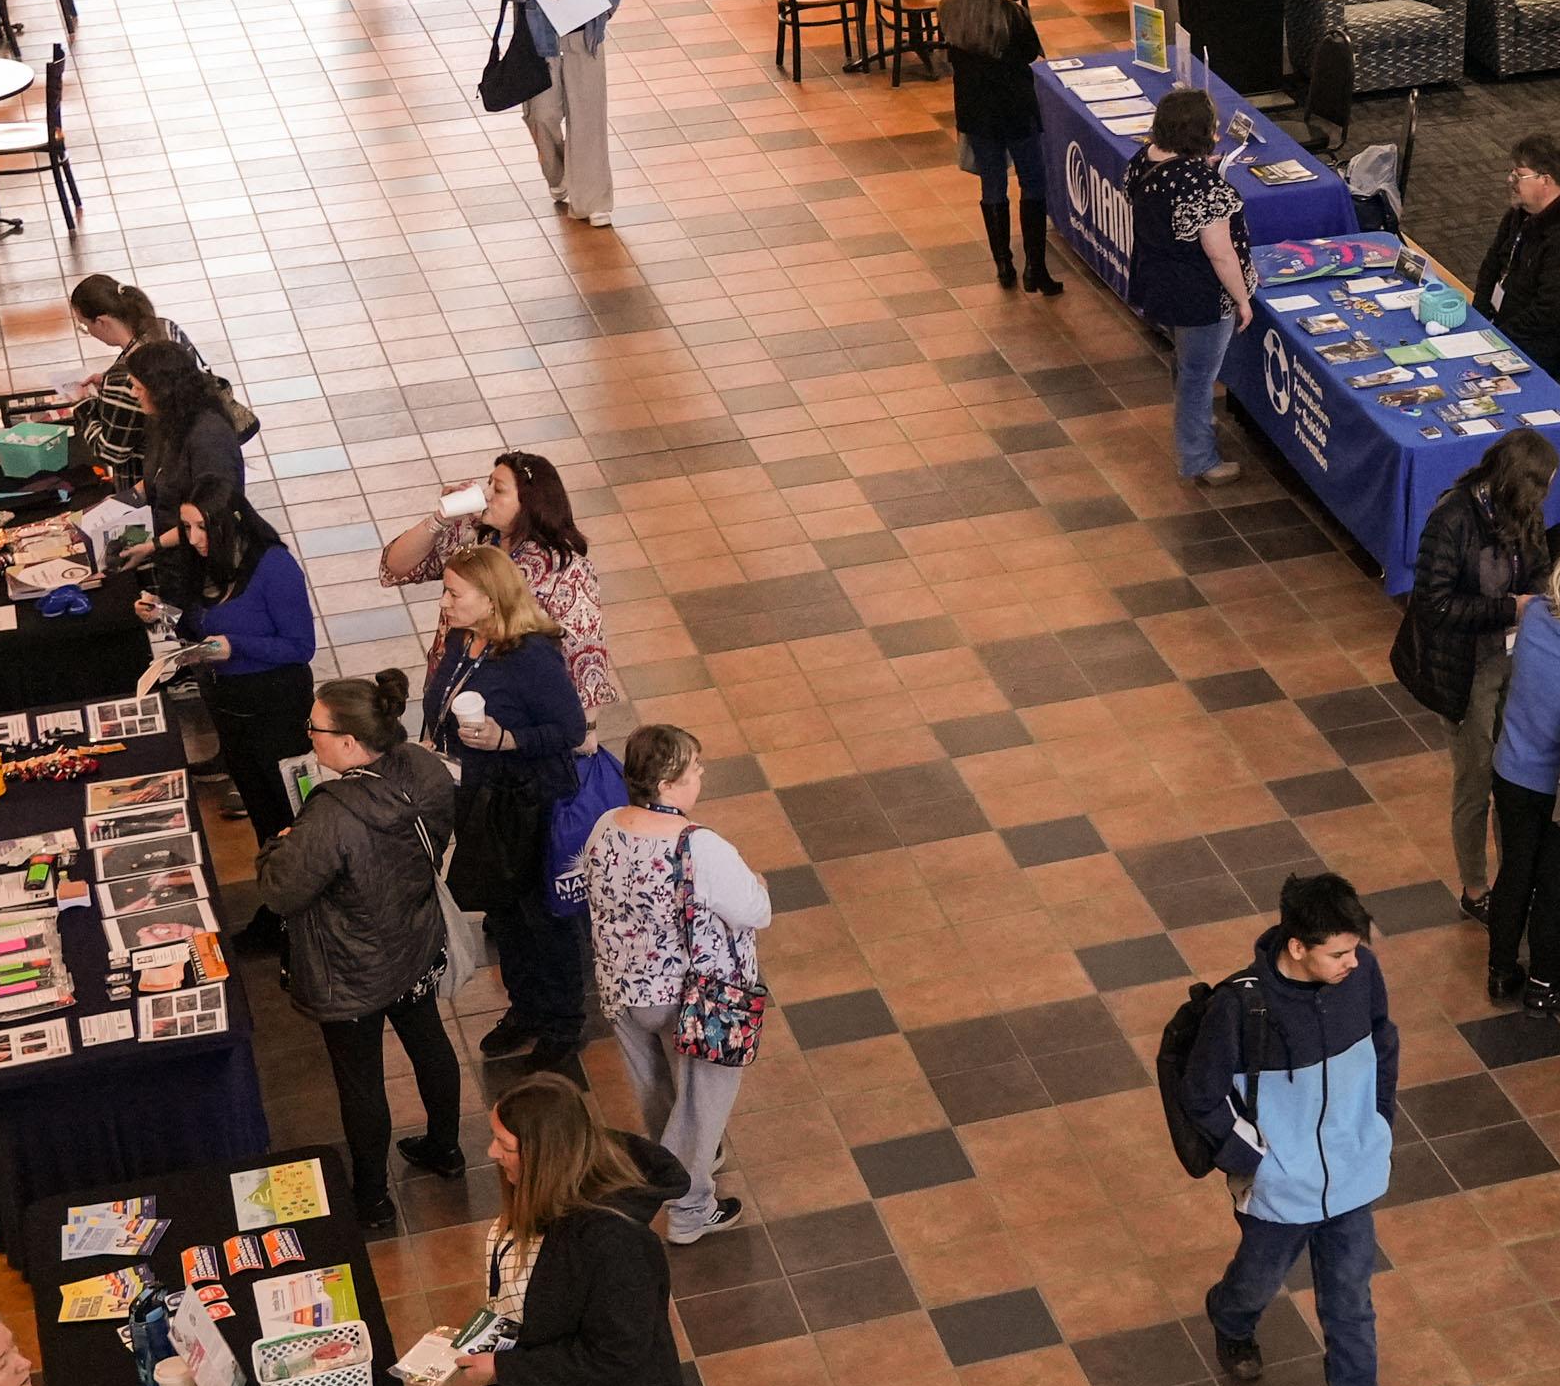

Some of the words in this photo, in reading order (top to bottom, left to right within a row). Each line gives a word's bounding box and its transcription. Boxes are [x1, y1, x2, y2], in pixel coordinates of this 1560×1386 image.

[1293, 355, 1323, 400] American
[1293, 376, 1331, 428] Foundation
[1294, 401, 1302, 415] for
[1295, 420, 1328, 472] Prevention
[1302, 408, 1327, 447] Suicide
